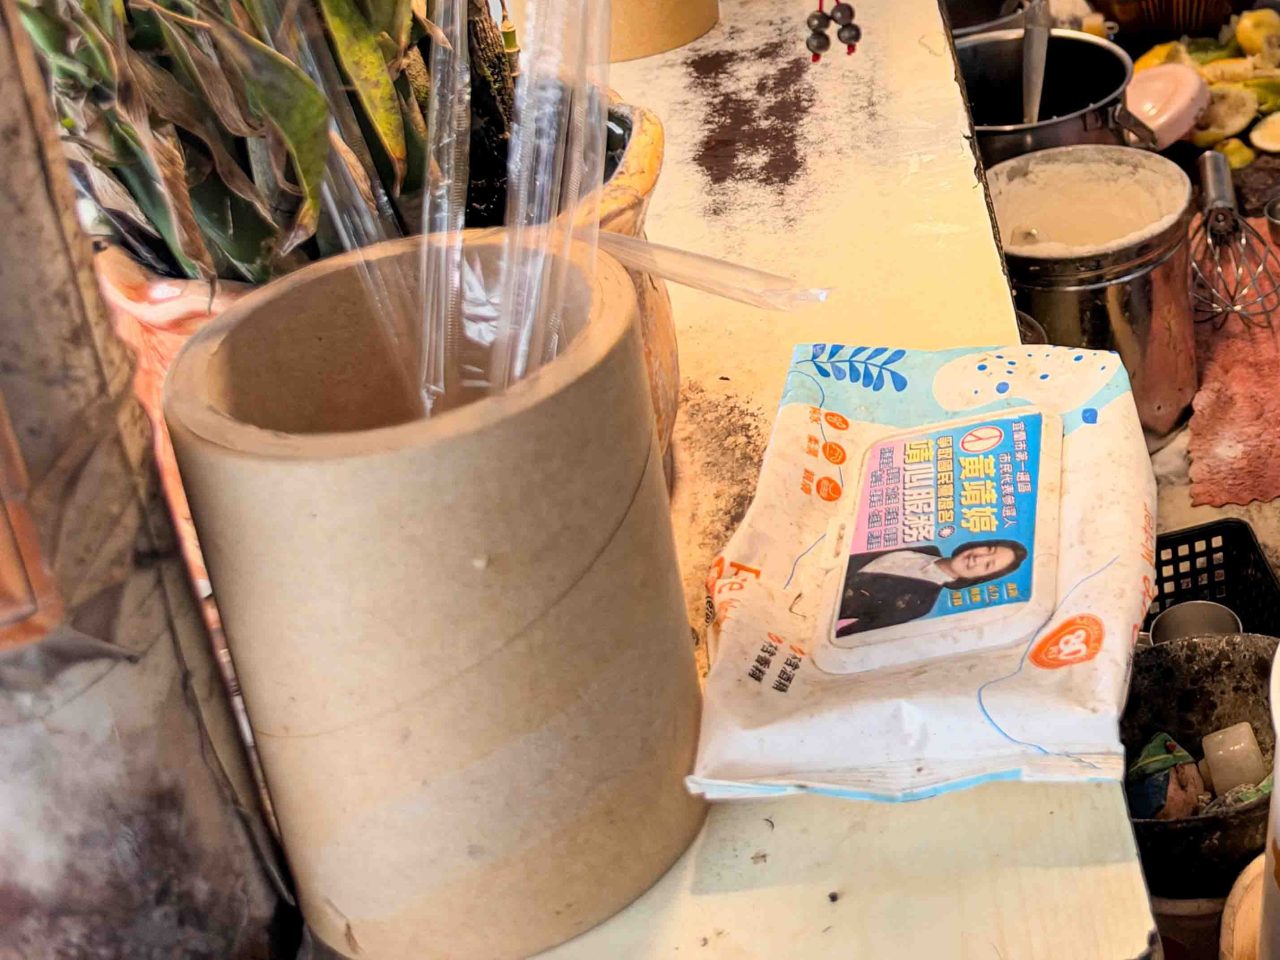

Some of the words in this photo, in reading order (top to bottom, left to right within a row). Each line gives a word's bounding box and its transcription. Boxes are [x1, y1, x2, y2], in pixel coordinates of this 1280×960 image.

[902, 438, 936, 544] 靖心服務
[957, 453, 999, 533] 黃靖婷
